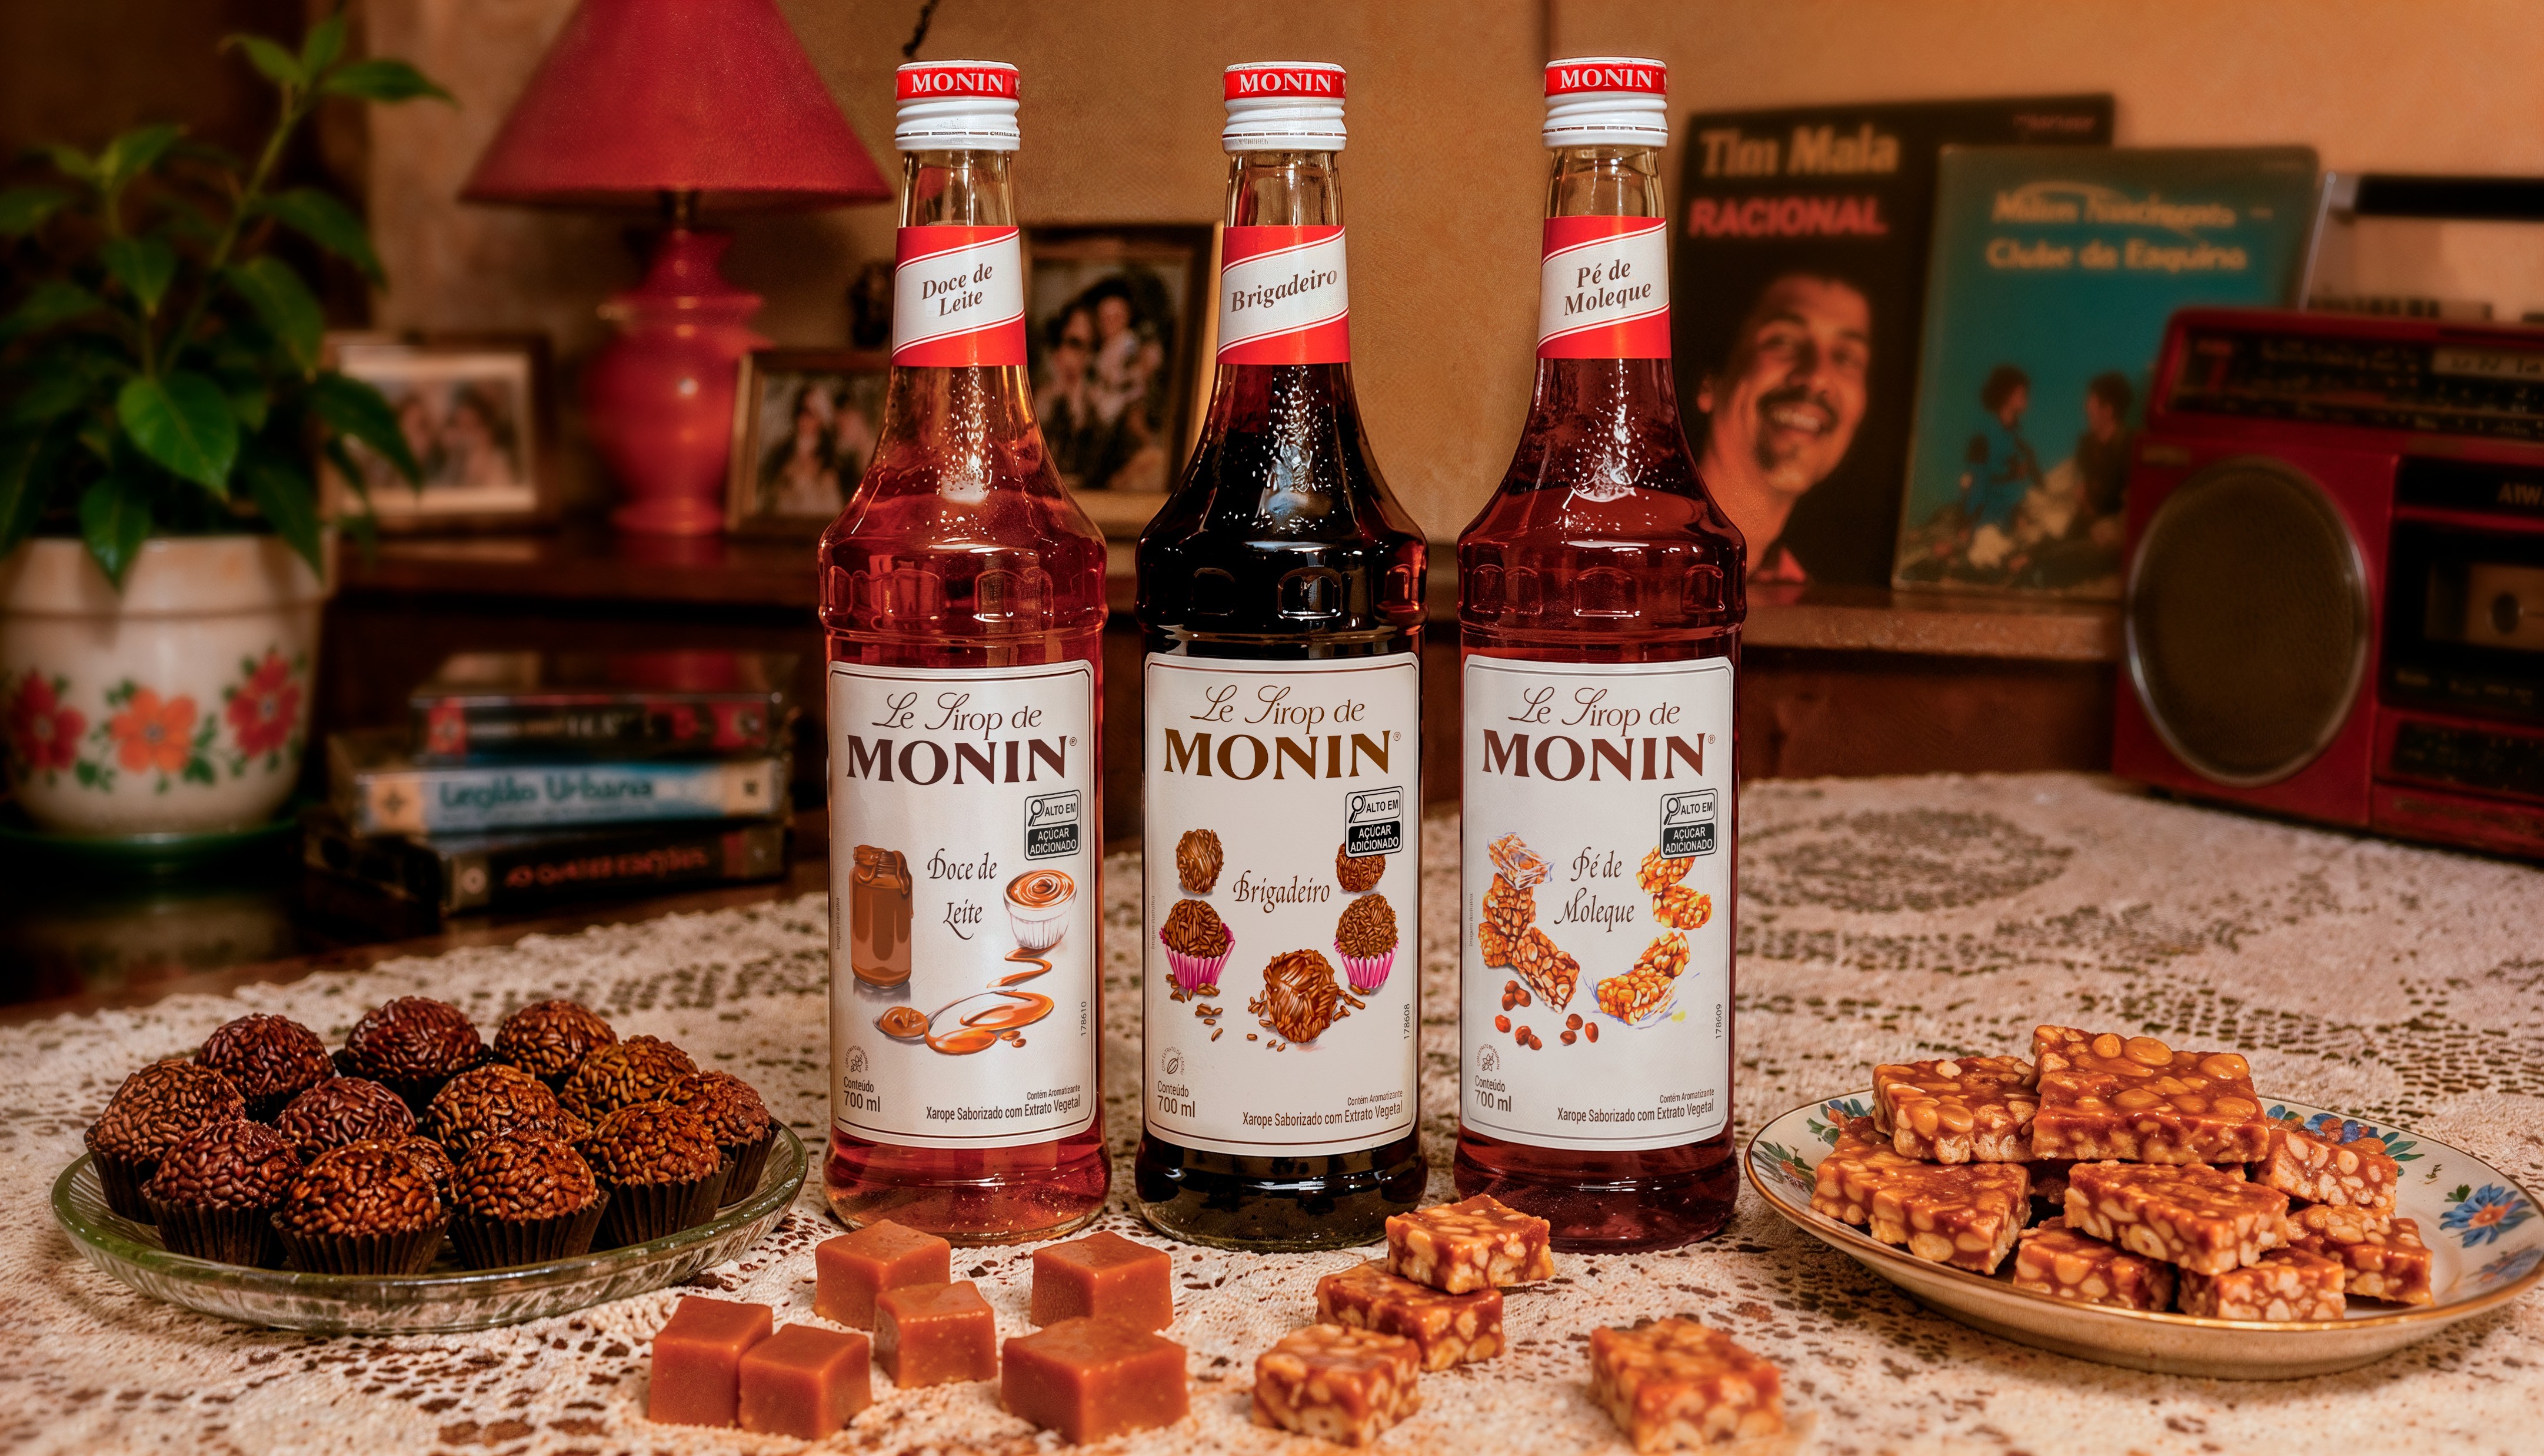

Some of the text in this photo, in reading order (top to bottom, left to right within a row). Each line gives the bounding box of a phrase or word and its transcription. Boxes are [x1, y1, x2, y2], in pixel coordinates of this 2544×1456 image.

[911, 73, 1003, 93] MONIN
[1238, 73, 1331, 93] MONIN
[1560, 69, 1652, 89] MONIN
[1689, 195, 1889, 238] RACIONAL
[922, 263, 993, 300] Doce de
[1577, 259, 1631, 288] Pé de
[1231, 269, 1337, 313] Brigadeiro
[1564, 283, 1651, 316] Moleque
[939, 291, 983, 317] Leite
[2497, 482, 2544, 506] AIW
[871, 692, 1042, 741] Le Sirop de
[1190, 685, 1365, 735] Le Sirop de
[1507, 687, 1680, 737] Le Sirop de
[1045, 803, 1075, 817] ALTO EM
[1366, 799, 1398, 813] ALTO EM
[1681, 802, 1713, 815] ALTO EM
[1038, 828, 1069, 842] AÇÚCAR
[1358, 824, 1391, 840] AÇÚCAR
[1673, 827, 1706, 841] AÇÚCAR
[1030, 839, 1076, 854] ADICIONADO
[1350, 837, 1398, 852] ADICIONADO
[1665, 839, 1713, 854] ADICIONADO
[927, 848, 997, 880] Doce de
[1570, 846, 1622, 882] Pé de
[1233, 869, 1330, 914] Brigadeiro
[943, 899, 983, 940] Leite
[1554, 887, 1634, 933] Moleque
[844, 1076, 874, 1093] Conteúdo
[1027, 1084, 1080, 1100] Contém Aromatizante
[1158, 1080, 1189, 1097] Conteúdo
[1475, 1075, 1505, 1092] Conteúdo
[844, 1090, 880, 1112] 700 ml
[1157, 1095, 1195, 1118] 700 ml
[1347, 1089, 1403, 1106] Contém Aromatizante
[1474, 1089, 1511, 1112] 700 ml
[1660, 1088, 1714, 1104] Contém Aromatizante
[927, 1094, 1080, 1122] Xarope Saborizado com Extrato Vegetal
[1243, 1100, 1403, 1129] Xarope Saborizado com Extrato Vegetal
[1557, 1098, 1714, 1124] Xarope Saborizado com Extrato Vegetal
